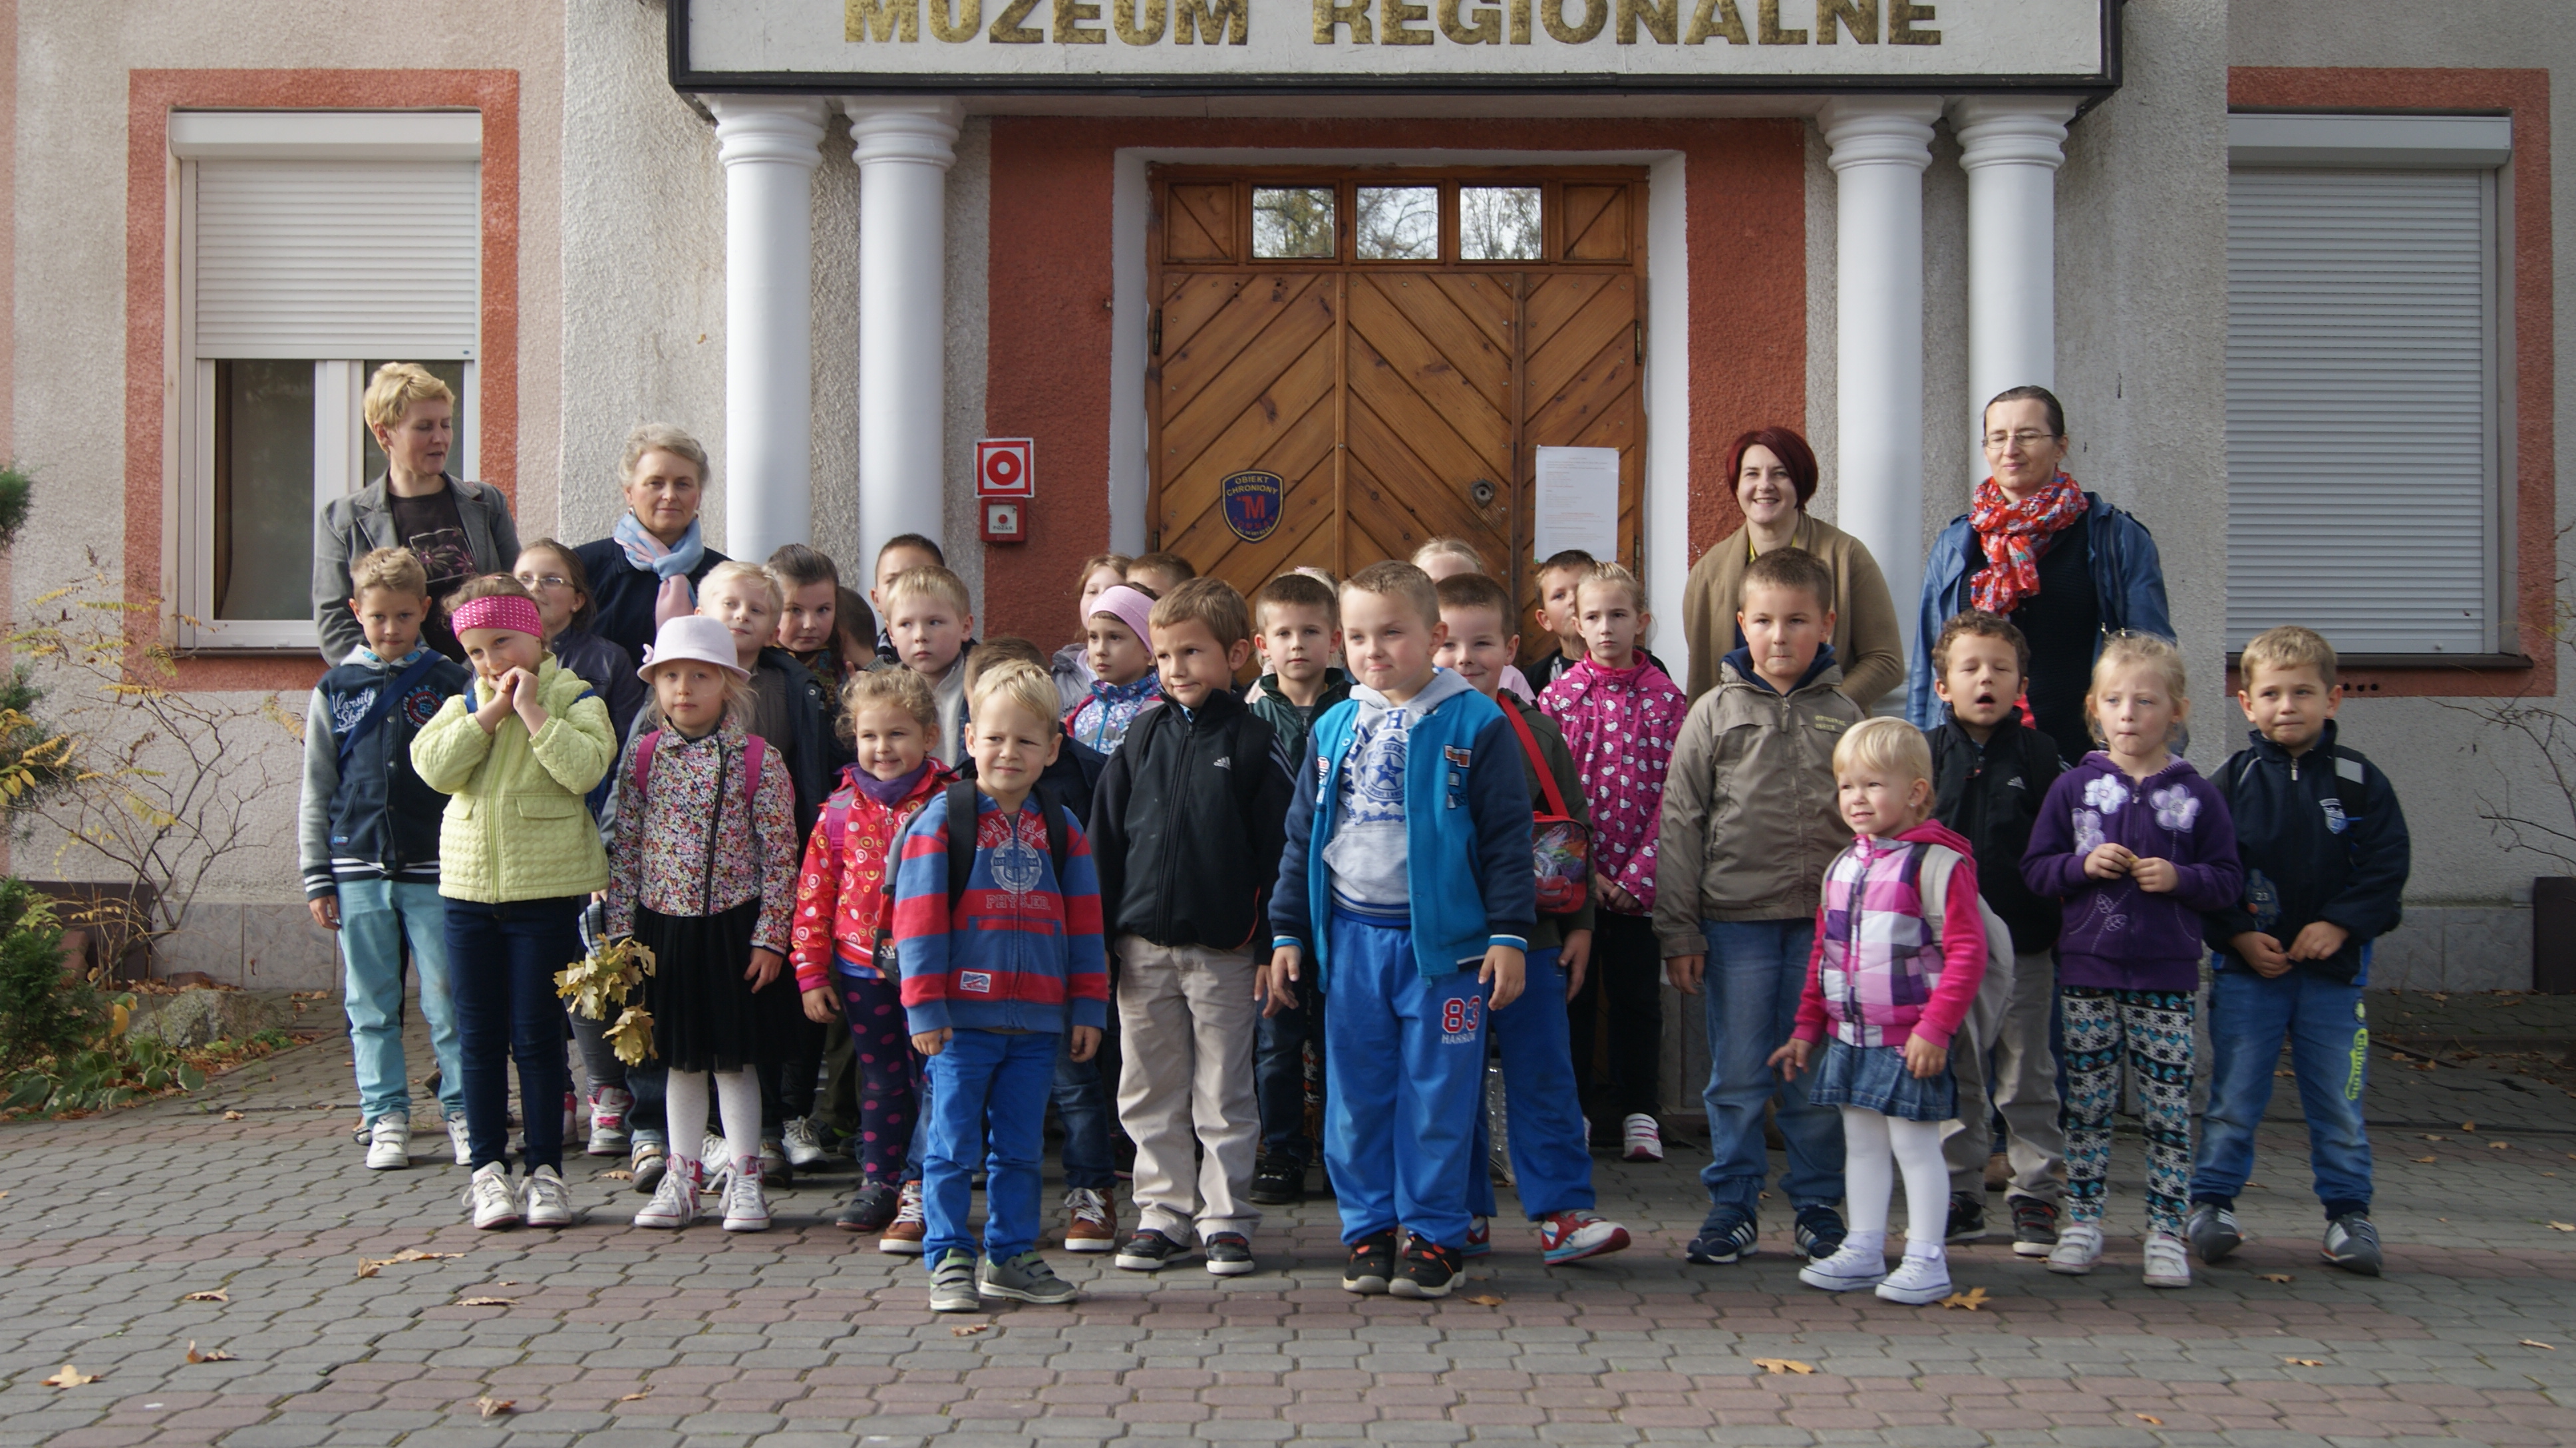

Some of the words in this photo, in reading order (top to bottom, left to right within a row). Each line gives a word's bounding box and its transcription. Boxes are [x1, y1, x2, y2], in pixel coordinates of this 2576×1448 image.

[845, 0, 1248, 46] MUZEUM
[1313, 0, 1943, 45] REGIONALNE
[1235, 475, 1269, 484] OBIEKT
[1226, 484, 1278, 496] CHRONIONY
[331, 687, 375, 715] Varsity
[2255, 892, 2269, 901] 23
[1442, 995, 1482, 1033] 83
